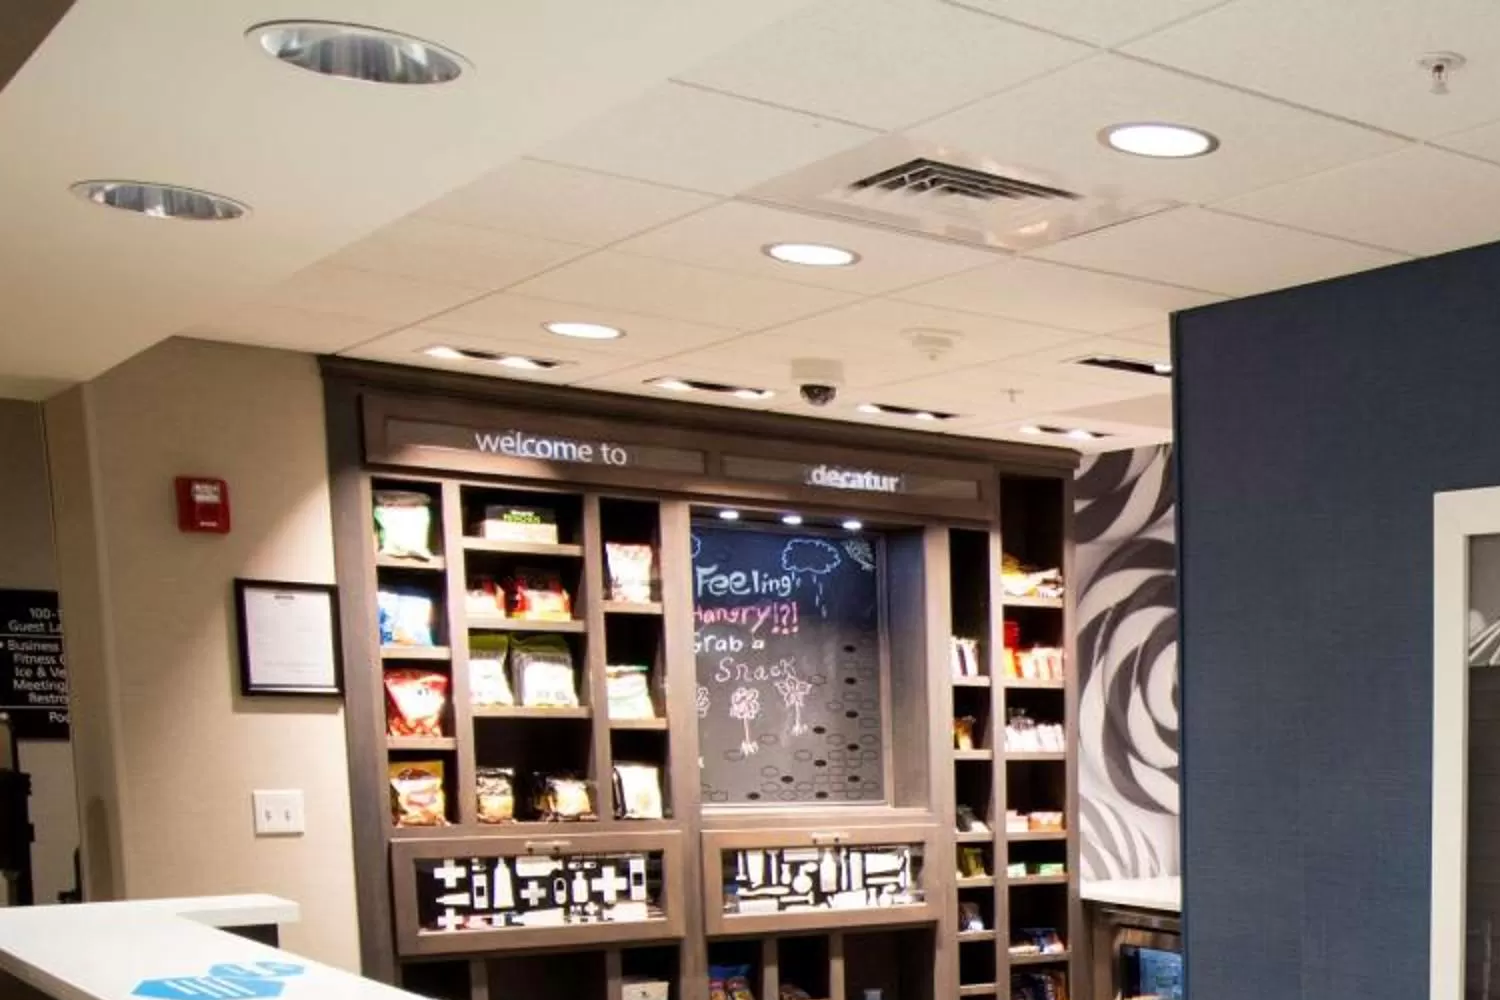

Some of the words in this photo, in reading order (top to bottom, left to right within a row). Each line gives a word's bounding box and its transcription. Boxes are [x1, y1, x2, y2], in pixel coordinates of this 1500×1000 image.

[475, 430, 593, 463] welcome
[600, 442, 628, 466] to
[810, 463, 899, 493] decatur
[695, 564, 792, 598] Feeling
[8, 619, 45, 632] Guest
[7, 639, 60, 653] Business
[751, 639, 765, 649] a
[13, 653, 57, 665] Fitness
